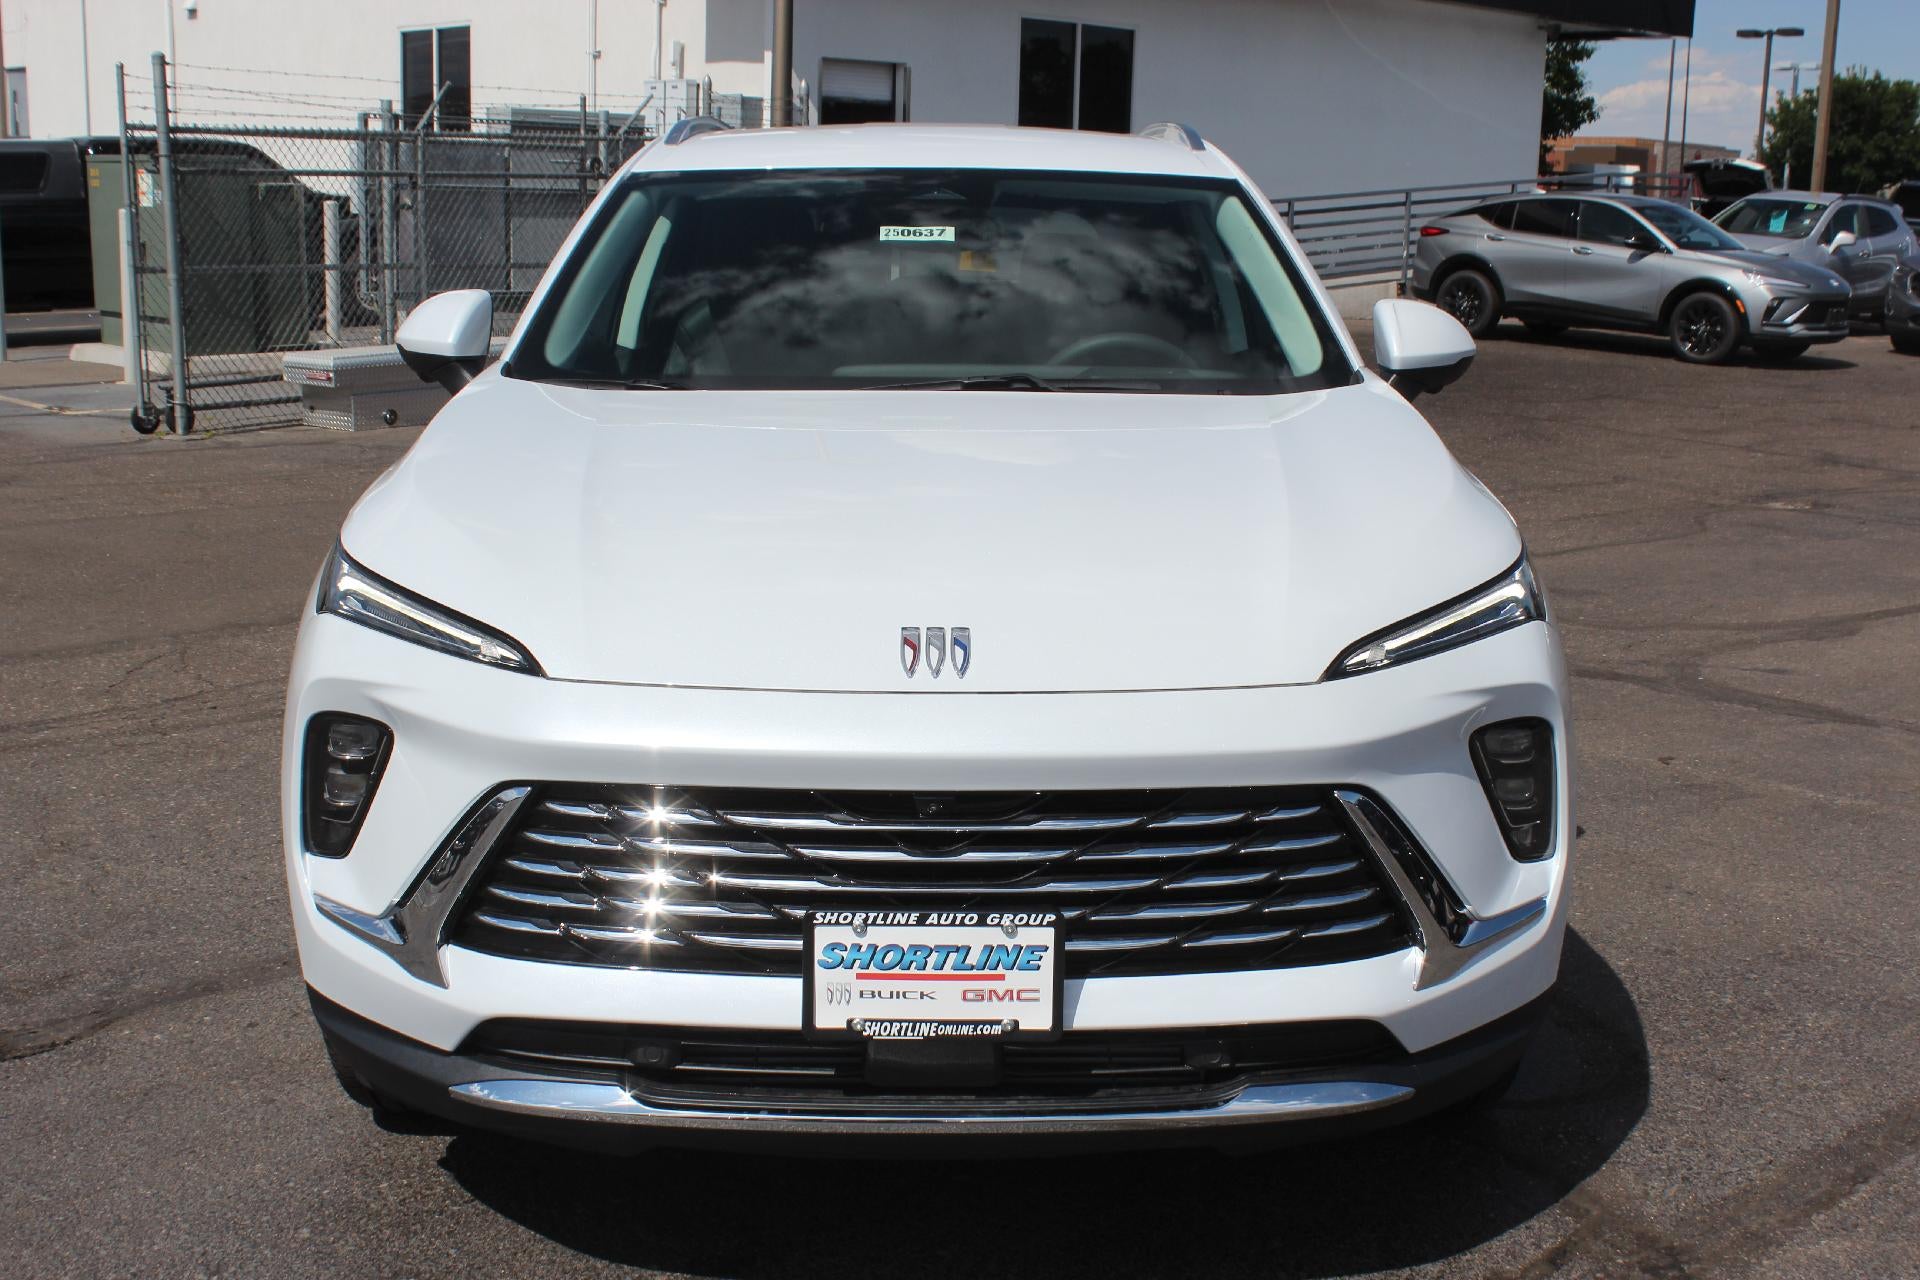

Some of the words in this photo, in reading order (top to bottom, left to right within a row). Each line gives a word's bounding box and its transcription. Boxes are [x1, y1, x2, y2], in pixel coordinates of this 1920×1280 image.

[883, 228, 947, 238] 250637
[813, 912, 920, 924] SHORTLINE
[925, 913, 979, 925] AUTO
[986, 913, 1057, 926] GROUP
[817, 942, 1050, 971] SHORTLINE
[859, 989, 938, 1000] BUICK
[961, 987, 1041, 1002] GMC
